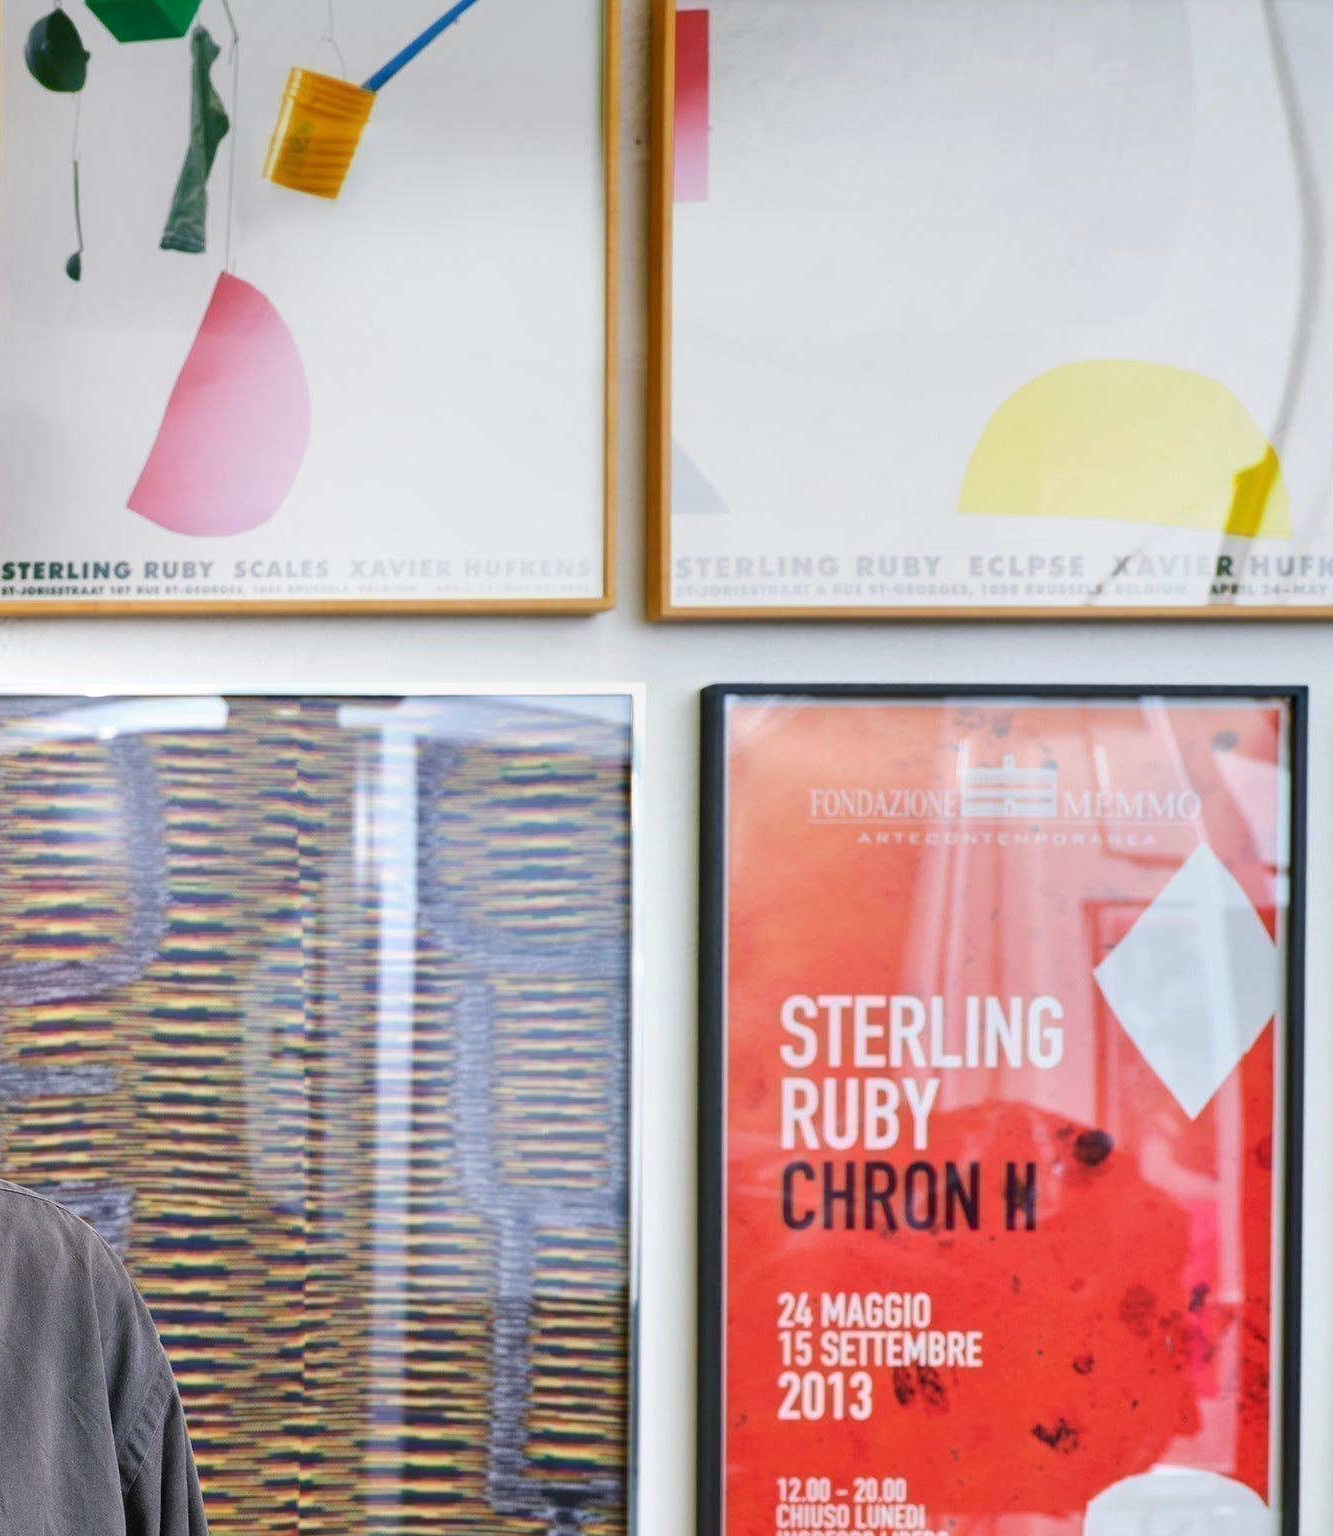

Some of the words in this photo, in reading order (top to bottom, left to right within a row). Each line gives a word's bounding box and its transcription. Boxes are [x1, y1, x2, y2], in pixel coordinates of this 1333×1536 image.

[0, 561, 133, 580] STERLING
[143, 560, 216, 580] RUBY
[233, 559, 329, 579] SCALES
[349, 559, 452, 578] XAVIER
[463, 559, 591, 578] HUFKENS
[674, 555, 840, 579] STERLING
[855, 555, 942, 578] RUBY
[968, 555, 1085, 577] ECLPSE
[1111, 555, 1234, 577] XAVIER
[809, 788, 960, 818] FONDAZIONE
[1063, 789, 1203, 819] MEMMO
[779, 994, 1065, 1070] STERLING
[780, 1077, 941, 1151] RUBY
[781, 1160, 981, 1232] CHRON
[777, 1291, 814, 1329] 24
[820, 1291, 932, 1329] MAGGIO
[777, 1330, 813, 1367] 15
[820, 1330, 984, 1368] SETTEMBRE
[777, 1370, 873, 1421] 2013
[776, 1476, 831, 1503] 12.00
[853, 1476, 907, 1503] 20.00
[775, 1503, 850, 1529] CHIUSO
